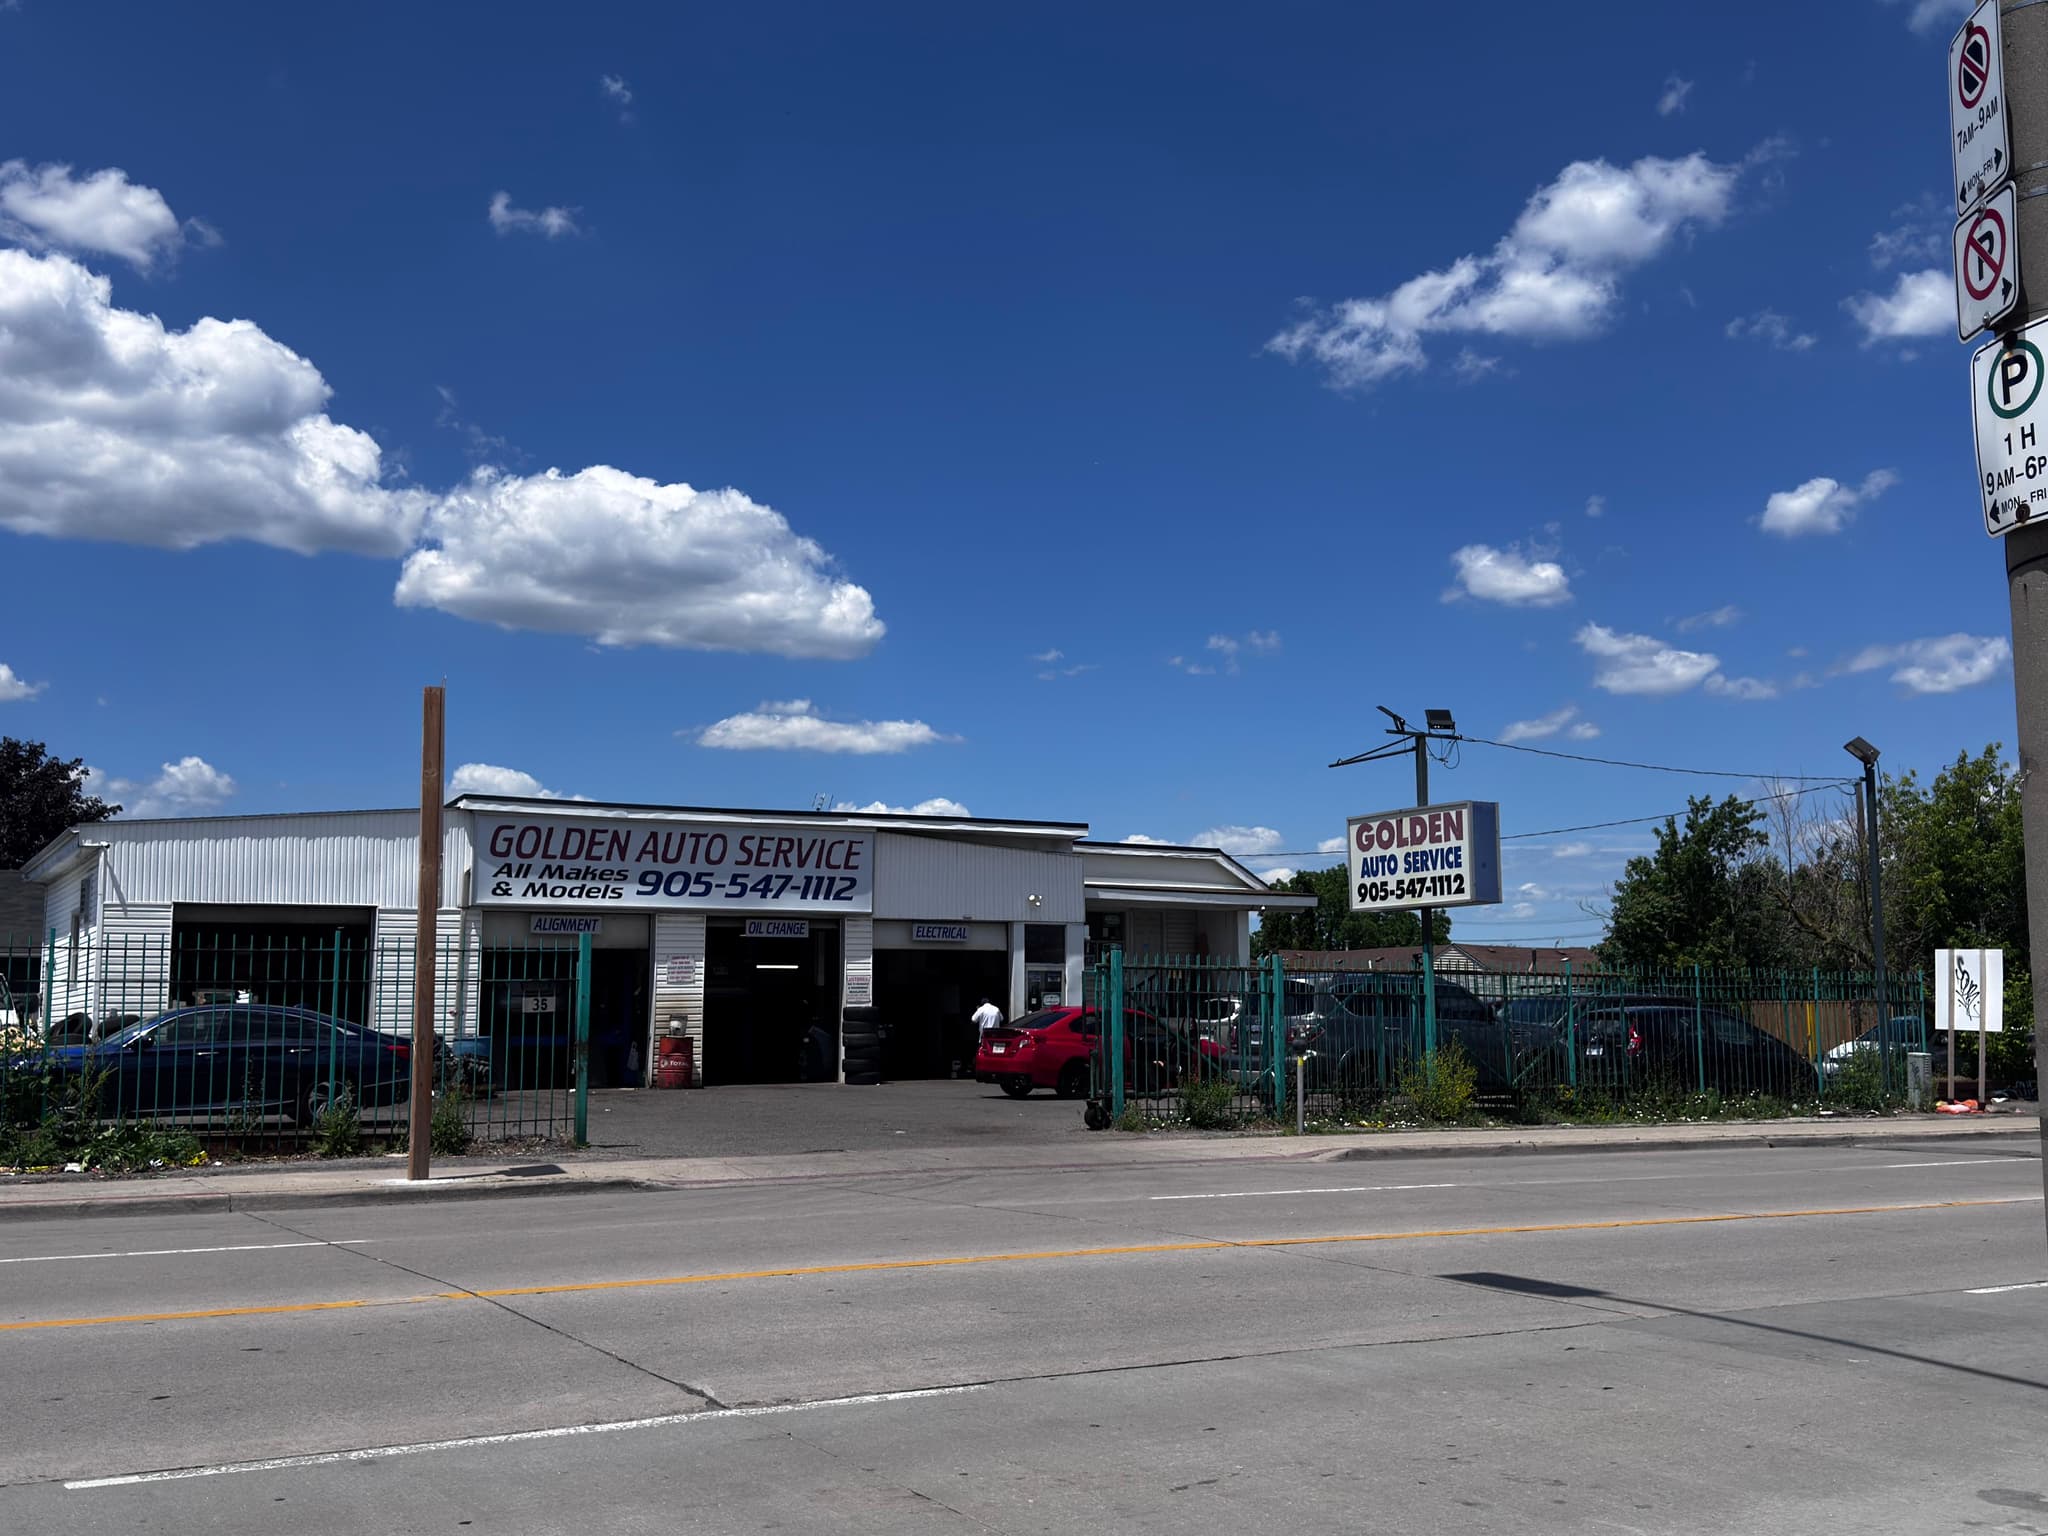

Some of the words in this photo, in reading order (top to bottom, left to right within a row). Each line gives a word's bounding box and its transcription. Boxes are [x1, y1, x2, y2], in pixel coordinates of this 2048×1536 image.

[1957, 96, 1999, 153] 7AM-9AM
[1967, 157, 1994, 192] MON-FRI
[2001, 354, 2028, 406] P
[2004, 433, 2013, 456] 1
[2021, 423, 2036, 450] H
[1356, 810, 1464, 852] GOLDEN
[489, 825, 631, 862] GOLDEN
[635, 831, 728, 865] AUTO
[734, 835, 864, 870] SERVICE
[1360, 854, 1398, 878] AUTO
[1404, 846, 1462, 874] SERVICE
[492, 863, 532, 878] All
[538, 864, 629, 881] Makes
[636, 870, 857, 901] 905-547-1112
[491, 881, 513, 897] &
[522, 882, 624, 899] Models
[1357, 873, 1465, 903] 905-547-1112
[533, 917, 599, 933] ALIGNMENT
[748, 922, 765, 935] OIL
[766, 922, 806, 936] CHANGE
[915, 925, 968, 939] ELECTRICAL
